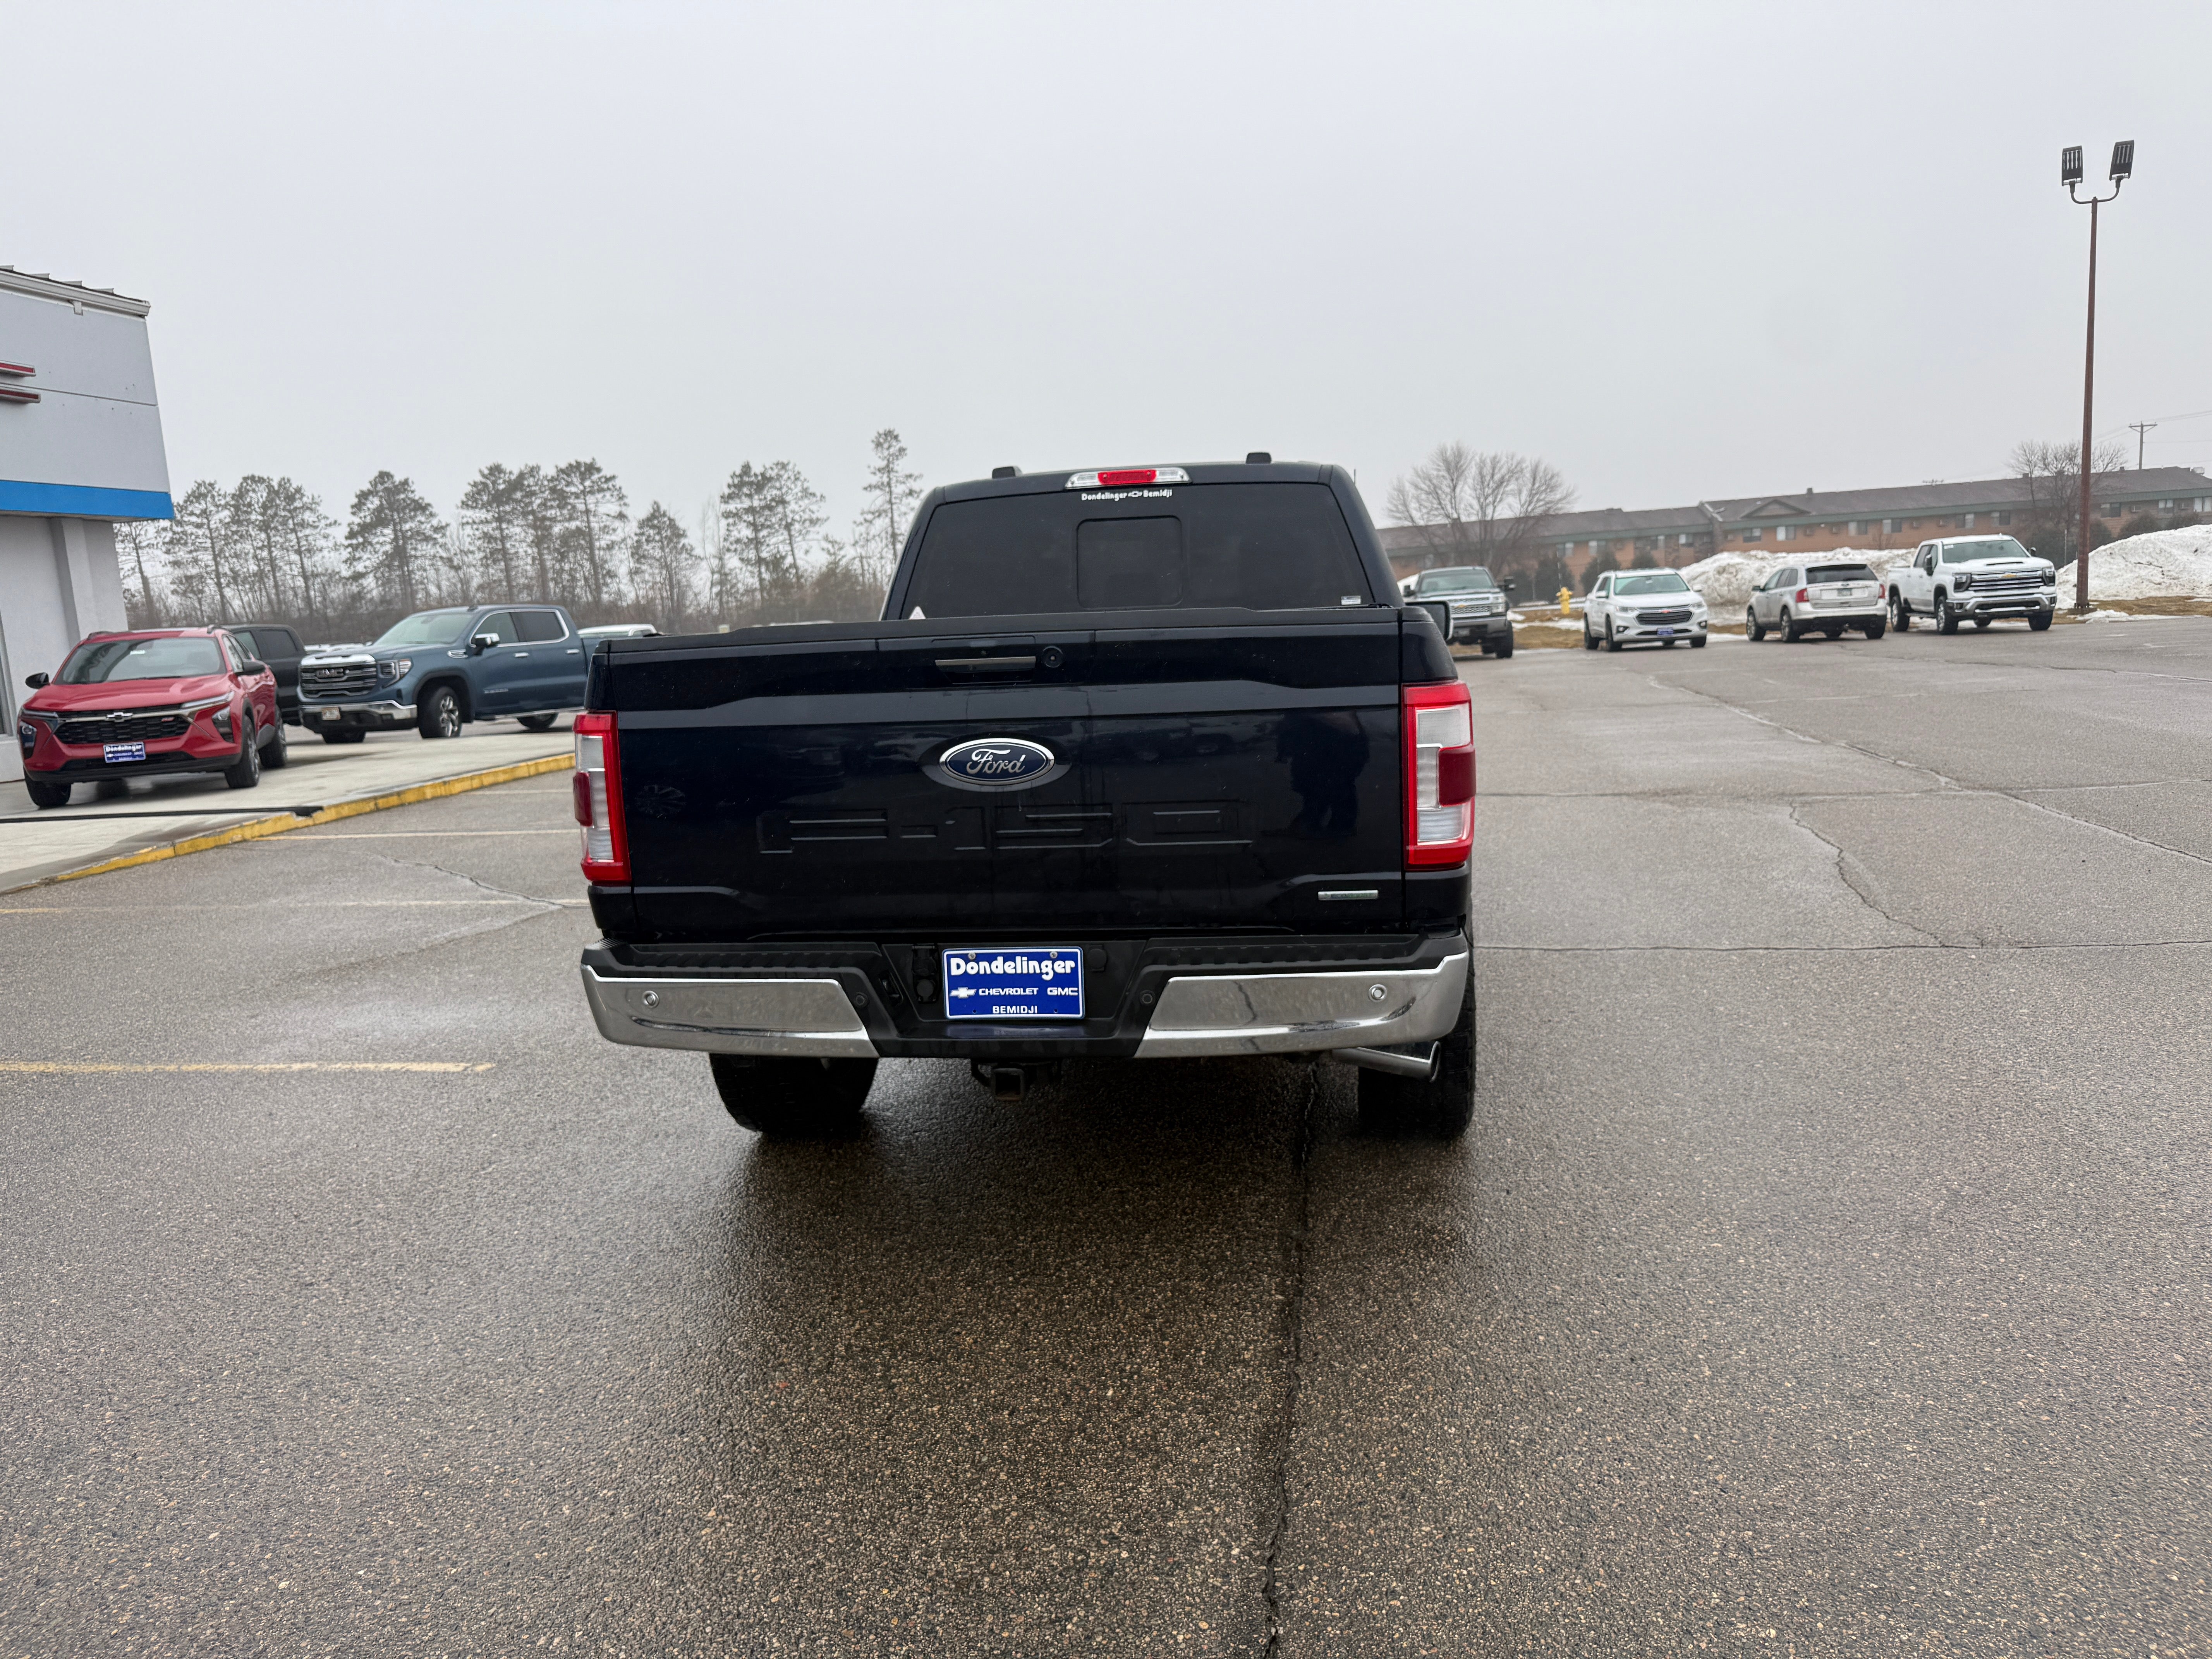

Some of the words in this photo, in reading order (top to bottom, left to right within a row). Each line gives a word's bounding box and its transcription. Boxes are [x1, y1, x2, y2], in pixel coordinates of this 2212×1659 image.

[1081, 492, 1127, 501] Dondelinger
[1144, 489, 1172, 498] Bemidji
[966, 749, 1026, 774] Ford
[950, 956, 1075, 981] Dondelinger
[979, 988, 1039, 996] CHEVROLET
[1047, 987, 1078, 996] GMC
[993, 1005, 1037, 1014] BEMIDJI
